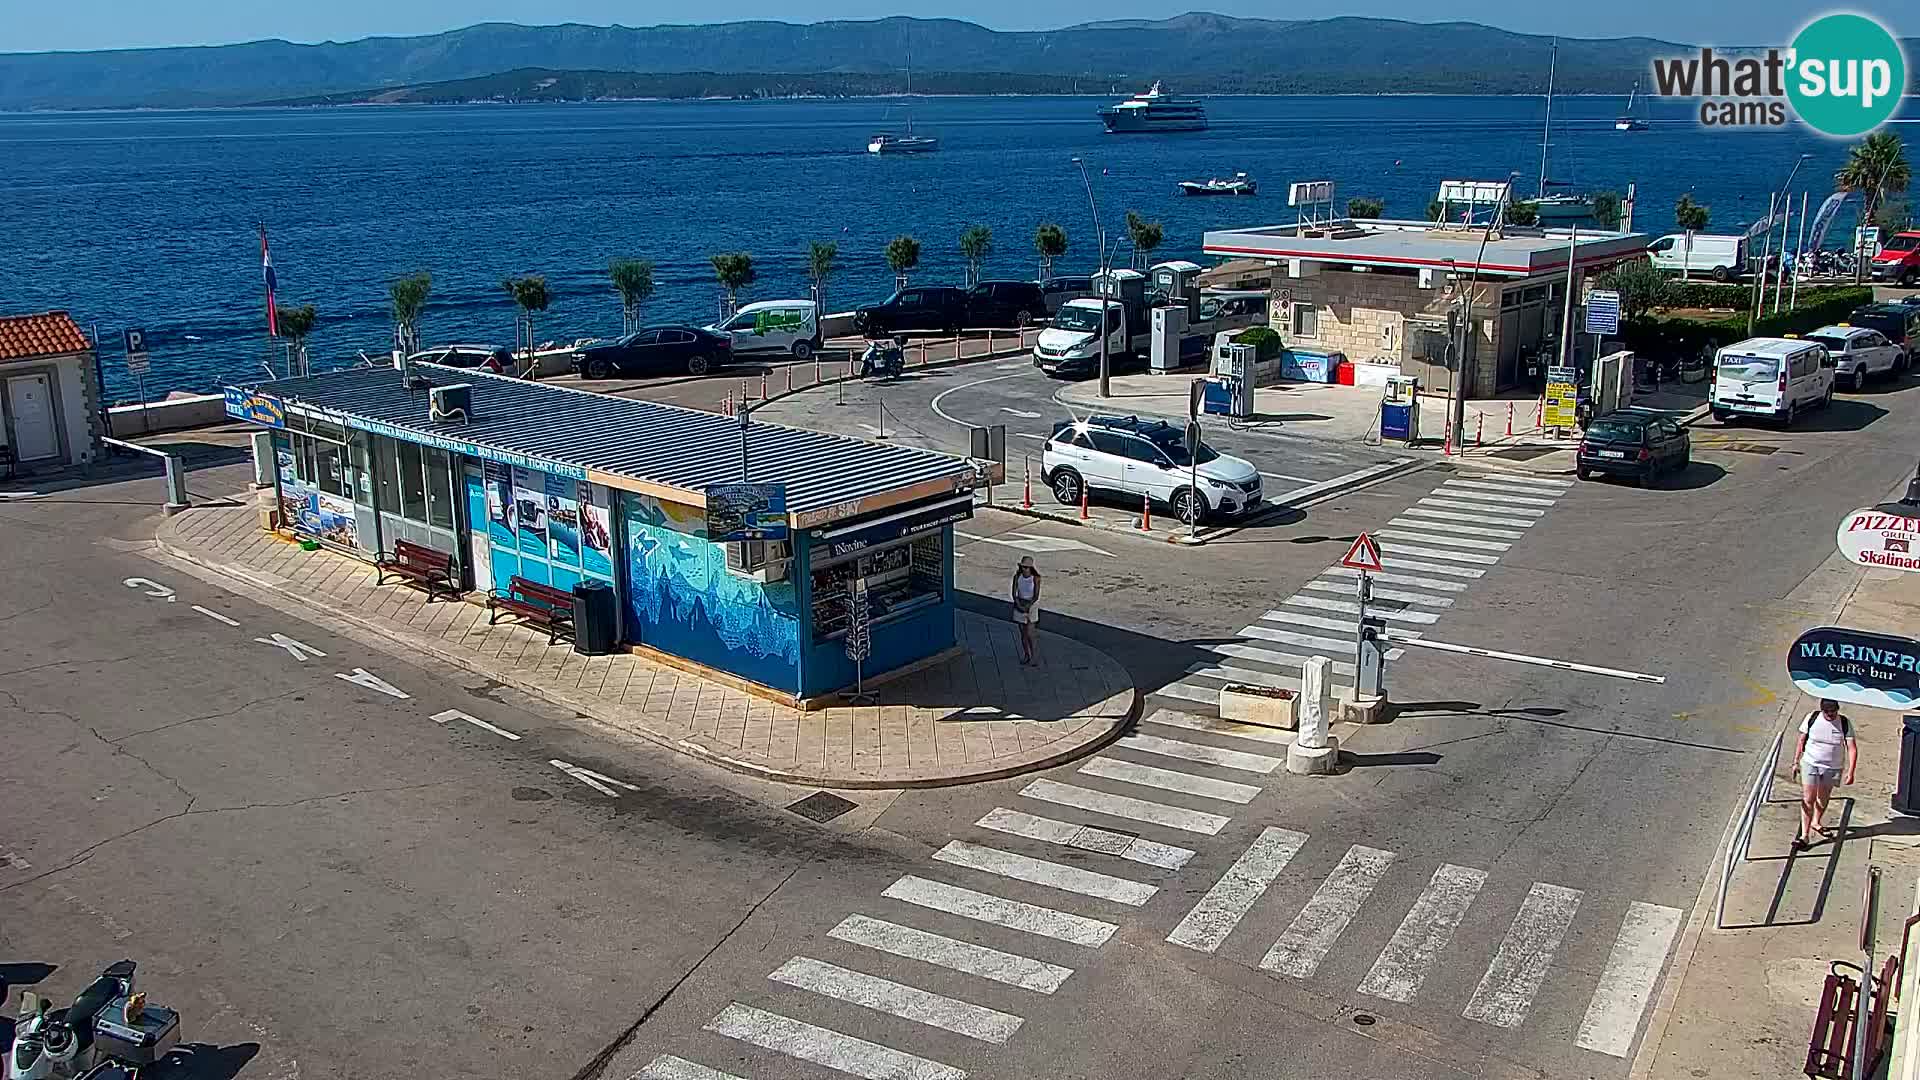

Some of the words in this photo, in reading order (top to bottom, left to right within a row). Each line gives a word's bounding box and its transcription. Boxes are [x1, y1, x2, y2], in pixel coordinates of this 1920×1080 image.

[129, 331, 142, 350] P
[1724, 356, 1741, 365] TAXI
[436, 438, 467, 452] POSTAJA
[478, 446, 492, 457] BUS
[494, 450, 526, 466] STATION
[527, 457, 554, 472] TICKET
[555, 463, 582, 478] OFFICE
[1848, 516, 1920, 533] PIZZE
[1881, 531, 1917, 541] GRILL
[1828, 663, 1866, 676] caffe
[1870, 666, 1896, 680] bar
